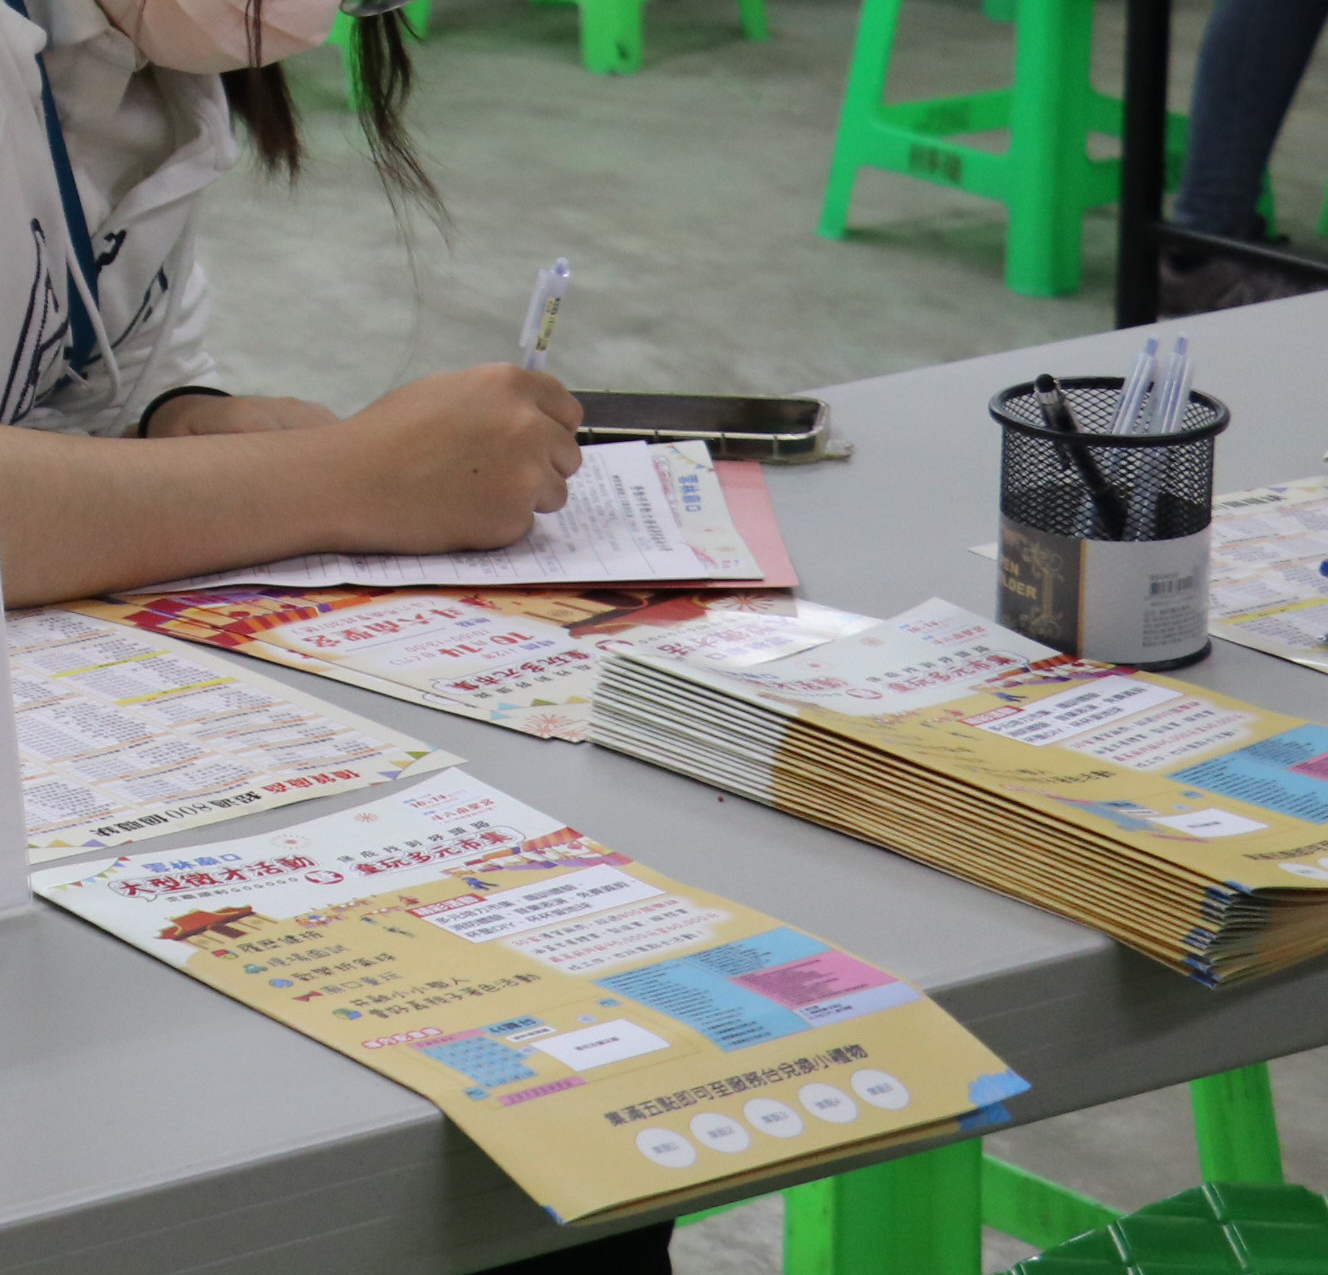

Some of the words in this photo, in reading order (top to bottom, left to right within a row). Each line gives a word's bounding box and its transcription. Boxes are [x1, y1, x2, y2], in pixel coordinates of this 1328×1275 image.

[298, 606, 467, 649] 斗六南聖宮
[443, 648, 593, 693] 童玩多元市集
[470, 664, 593, 699] 庇找到好頭路
[140, 852, 243, 873] 雲林廟口
[350, 828, 514, 875] 童玩多元市集
[112, 852, 319, 897] 大型徵才活動
[596, 1043, 876, 1126] 集滿五點即可至服務台兌換小禮物
